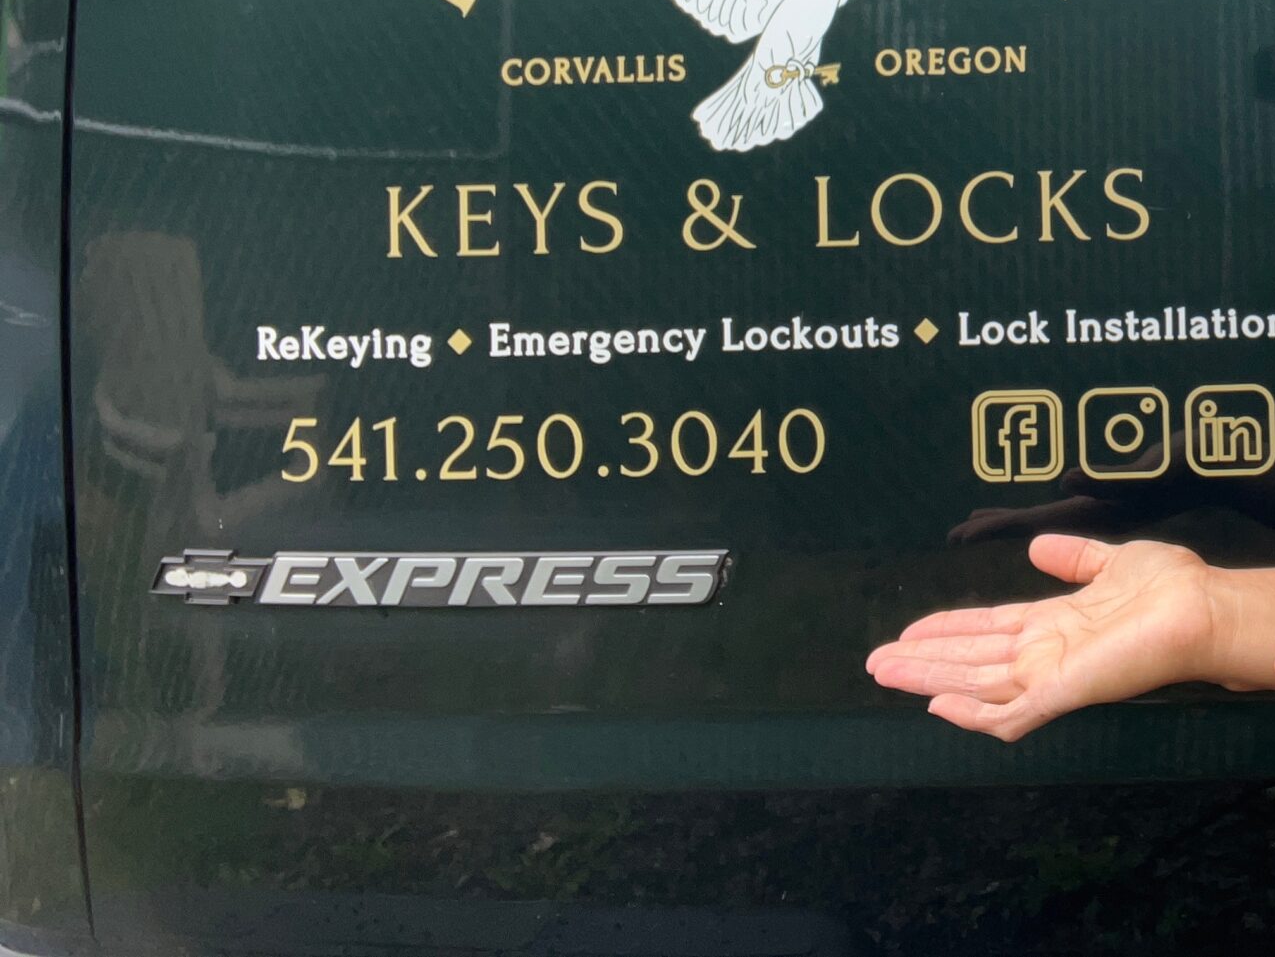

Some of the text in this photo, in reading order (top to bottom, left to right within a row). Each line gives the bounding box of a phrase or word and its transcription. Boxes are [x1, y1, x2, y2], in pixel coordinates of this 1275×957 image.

[500, 54, 687, 86] CORVALLIS
[875, 45, 1028, 76] OREGON
[386, 167, 1152, 258] KEYS & LOCKS
[256, 326, 433, 367] ReKeying
[489, 323, 705, 363] Emergency
[721, 317, 900, 352] Lockouts
[958, 310, 1050, 346] Lock
[281, 408, 826, 482] 541.250.3040
[259, 555, 721, 605] EXPRESS
